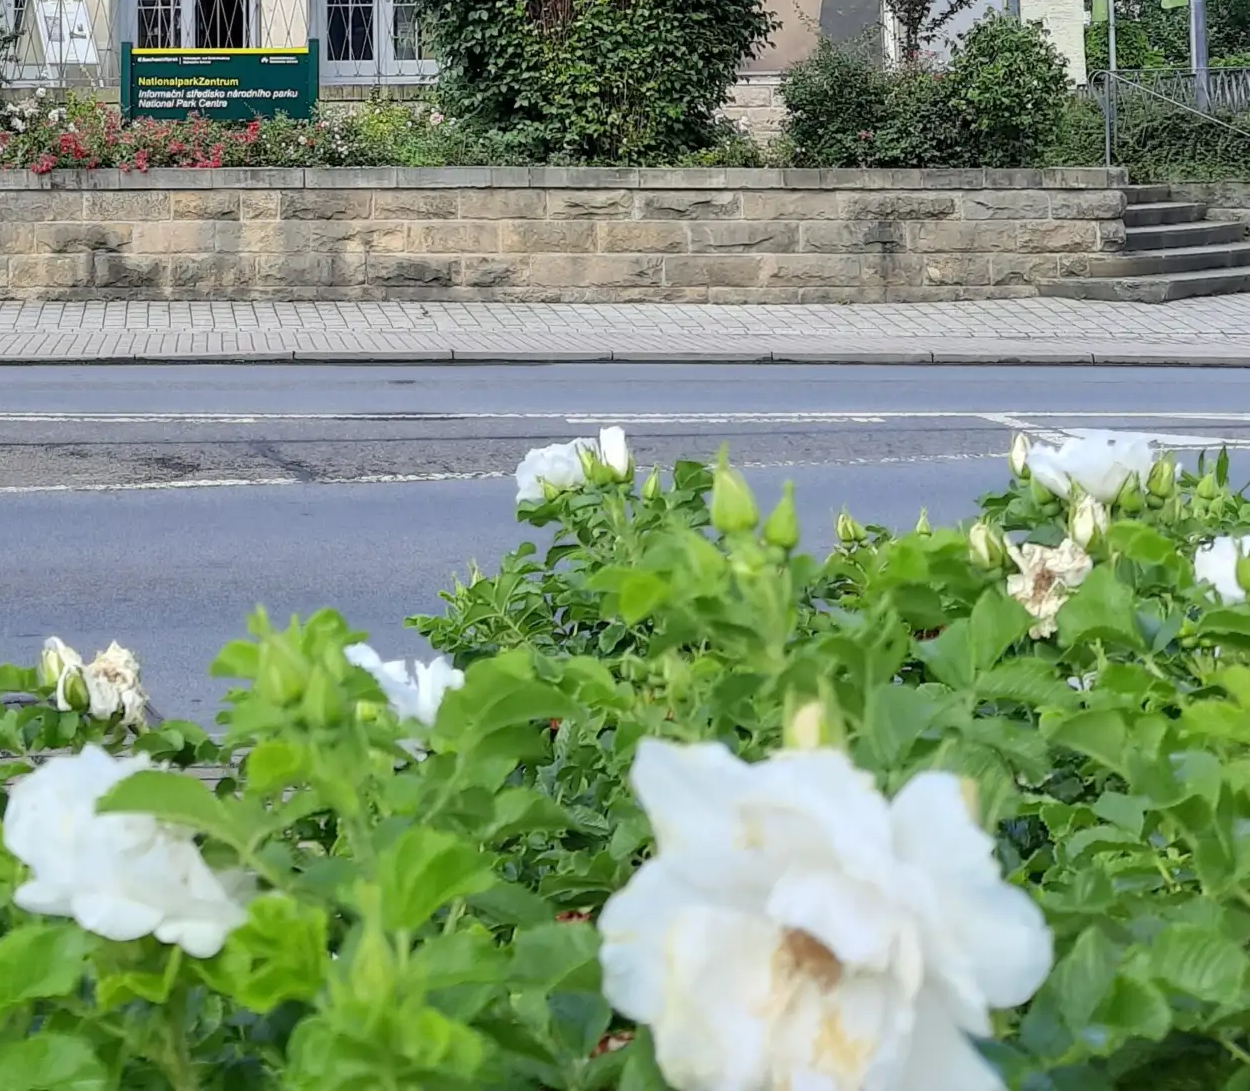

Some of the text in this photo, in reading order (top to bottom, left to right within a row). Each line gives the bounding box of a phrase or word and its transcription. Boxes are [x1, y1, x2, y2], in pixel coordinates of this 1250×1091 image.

[138, 76, 240, 89] NationalparkZentrum
[272, 88, 298, 100] parku
[138, 98, 228, 109] National Park Centre
